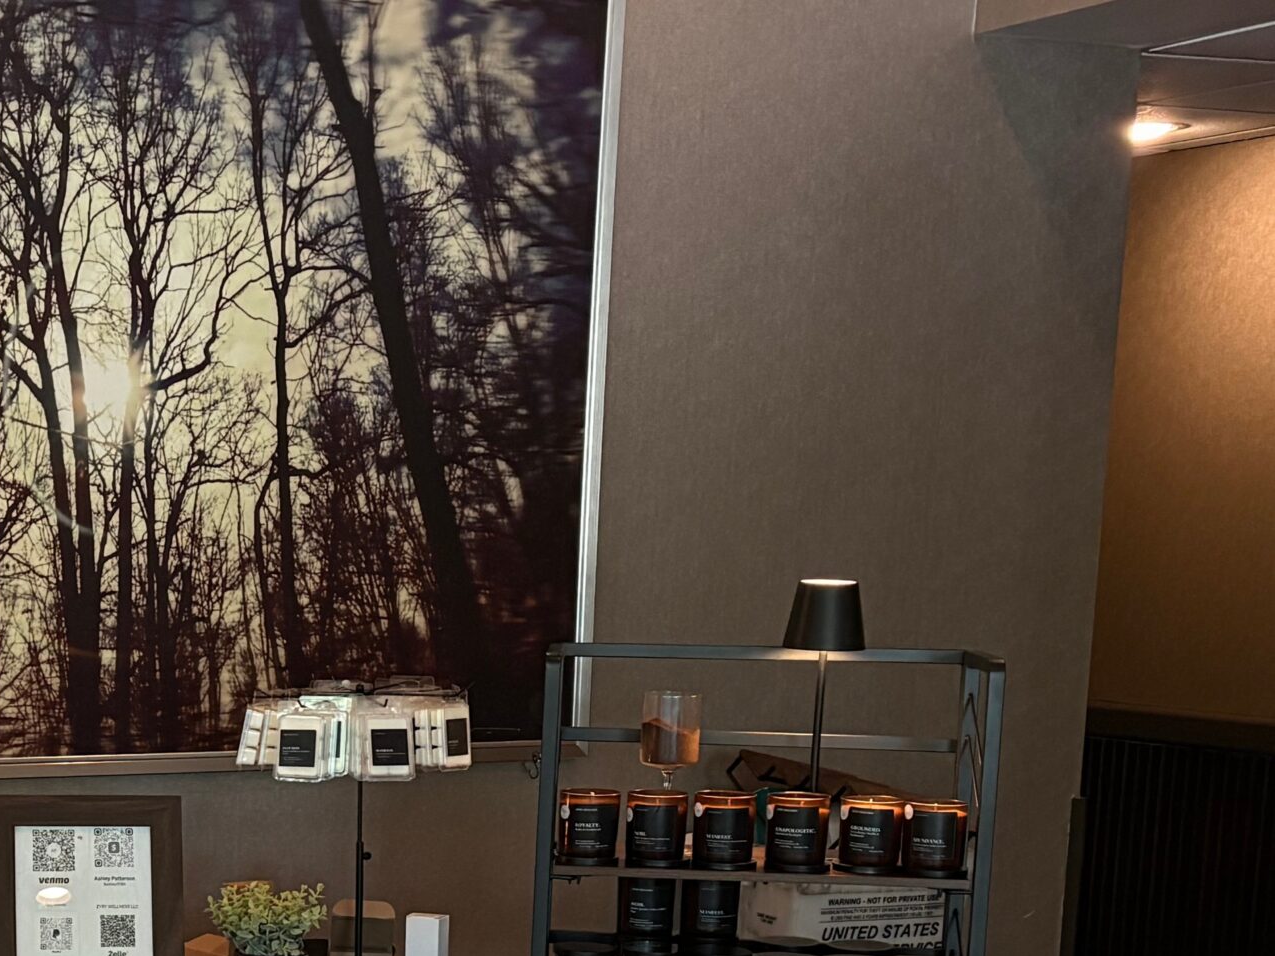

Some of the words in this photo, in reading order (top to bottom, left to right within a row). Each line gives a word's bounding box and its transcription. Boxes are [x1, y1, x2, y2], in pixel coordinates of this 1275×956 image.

[828, 898, 861, 906] WARNING
[867, 897, 881, 905] NOT
[821, 925, 879, 941] UNITED
[882, 921, 940, 938] STATES
